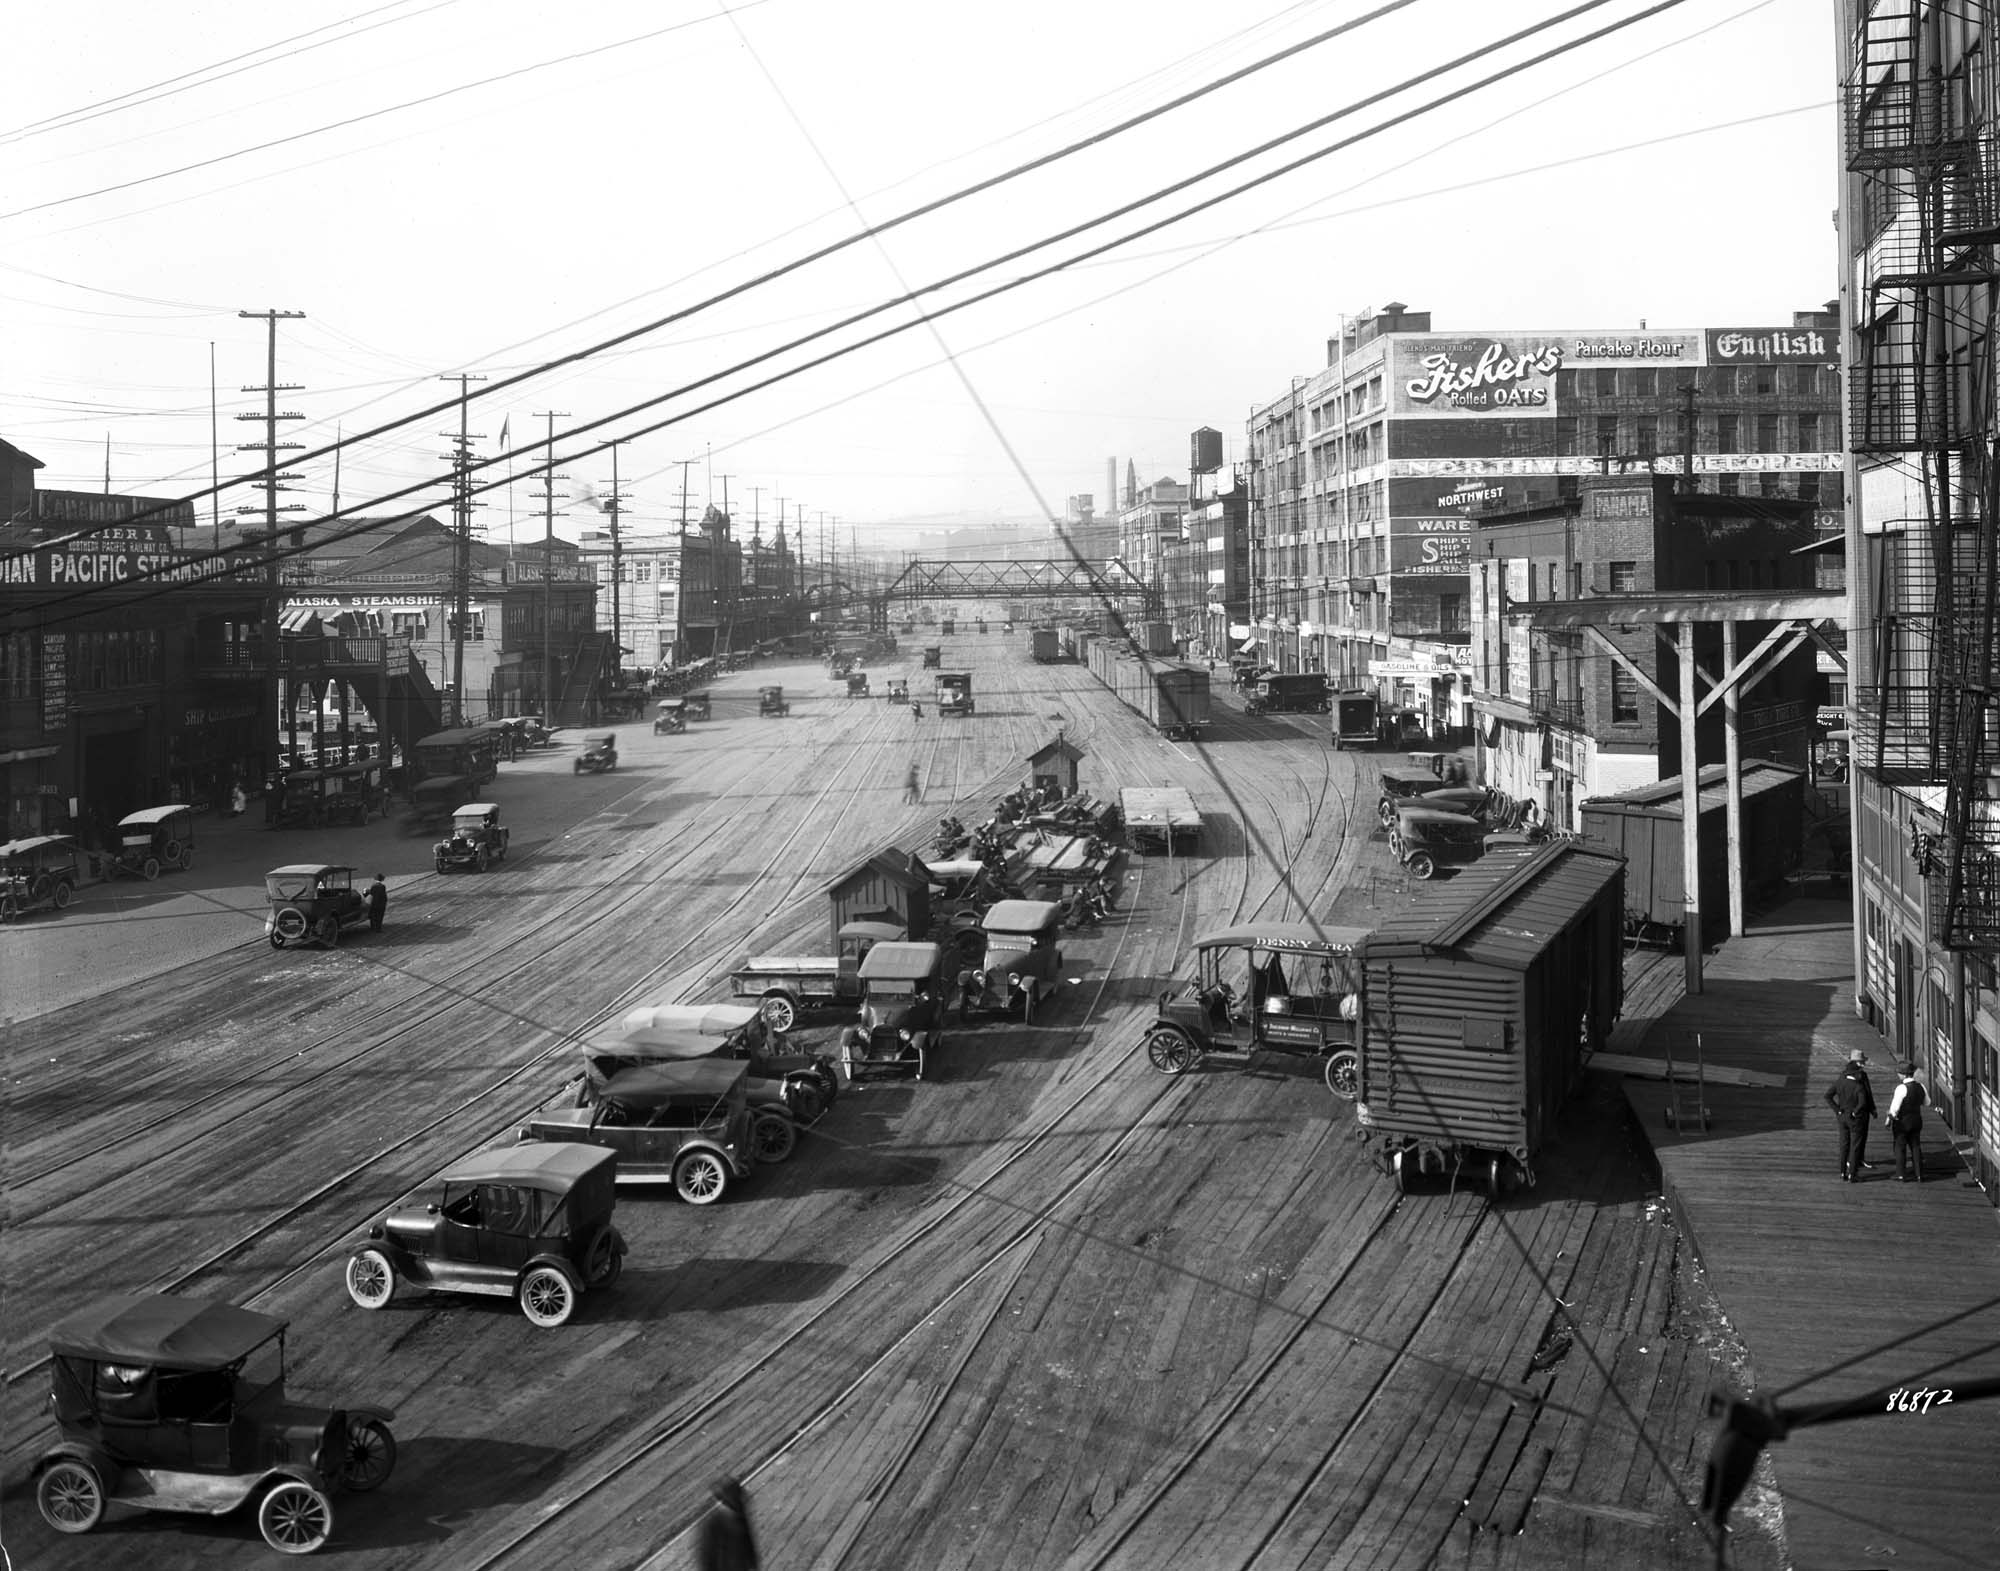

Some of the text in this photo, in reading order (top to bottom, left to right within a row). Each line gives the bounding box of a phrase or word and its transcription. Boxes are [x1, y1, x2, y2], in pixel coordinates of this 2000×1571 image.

[1575, 339, 1684, 358] Pancake Flour
[1715, 331, 1827, 362] English
[1405, 343, 1562, 400] Fisher's
[1451, 388, 1546, 405] Rolled OATS
[1437, 486, 1504, 508] NORTHWEST
[1417, 520, 1471, 531] WARE
[68, 541, 99, 552] NORTHERN
[102, 541, 126, 552] PACIFIC
[130, 542, 156, 553] RAILWAY
[50, 553, 128, 584] PACIFIC
[137, 555, 227, 583] STEAMSHIP
[286, 597, 341, 606] ALASKA
[1256, 936, 1312, 948] DENNY
